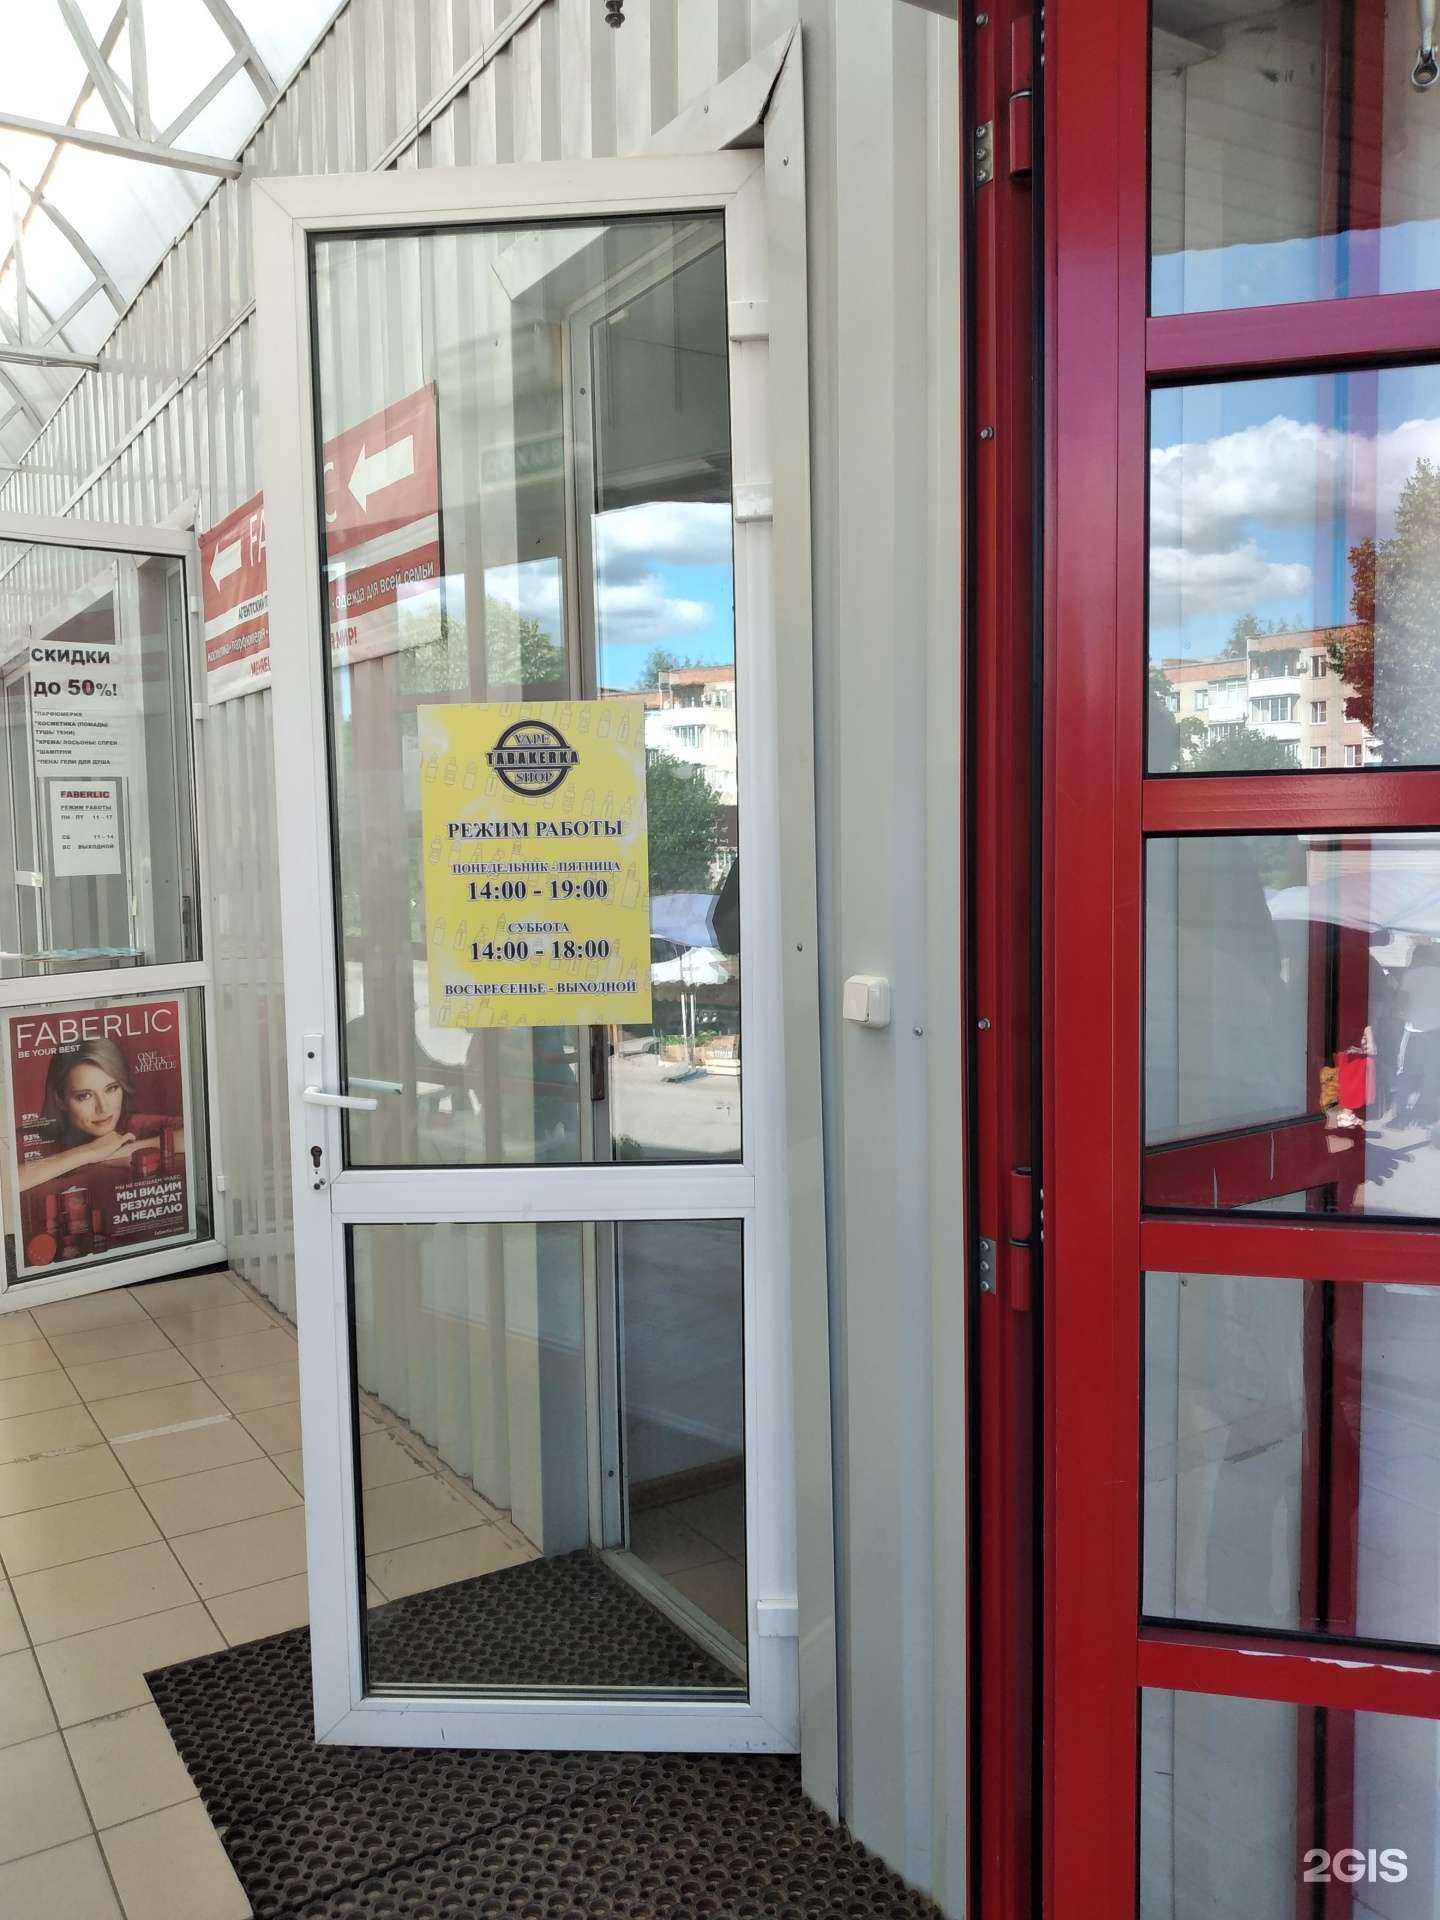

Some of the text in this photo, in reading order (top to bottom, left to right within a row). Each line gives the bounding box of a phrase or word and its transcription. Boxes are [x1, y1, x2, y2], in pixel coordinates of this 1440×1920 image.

[367, 582, 378, 601] для
[380, 569, 401, 593] всей
[404, 562, 434, 584] семьи
[31, 648, 110, 665] СКИДКИ
[68, 679, 117, 697] 50%!
[515, 772, 553, 783] SHOP
[60, 790, 111, 799] FABERLIC
[448, 820, 623, 839] РЕЖИМ РАБОТЫ
[452, 862, 548, 874] ПОНЕДЕЛЬНИК
[558, 861, 621, 873] ПЯТНИЦА
[468, 882, 526, 900] 14:00
[550, 880, 608, 899] 19:00
[507, 922, 569, 933] СУББОТА
[470, 942, 528, 960] 14:00
[551, 940, 610, 959] 18:00
[445, 983, 545, 995] ВОСКРЕСЕНЬЕ
[557, 981, 637, 994] ВЫХОДНОЙ
[16, 1009, 172, 1048] FABERLIC
[18, 1044, 81, 1059] BE YOUR BEST
[116, 1181, 182, 1202] МЫ ВИДИМ
[120, 1192, 182, 1212] РЕЗУЛЬТАТ
[112, 1214, 129, 1225] ЗА
[131, 1203, 183, 1220] НЕДЕЛЮ
